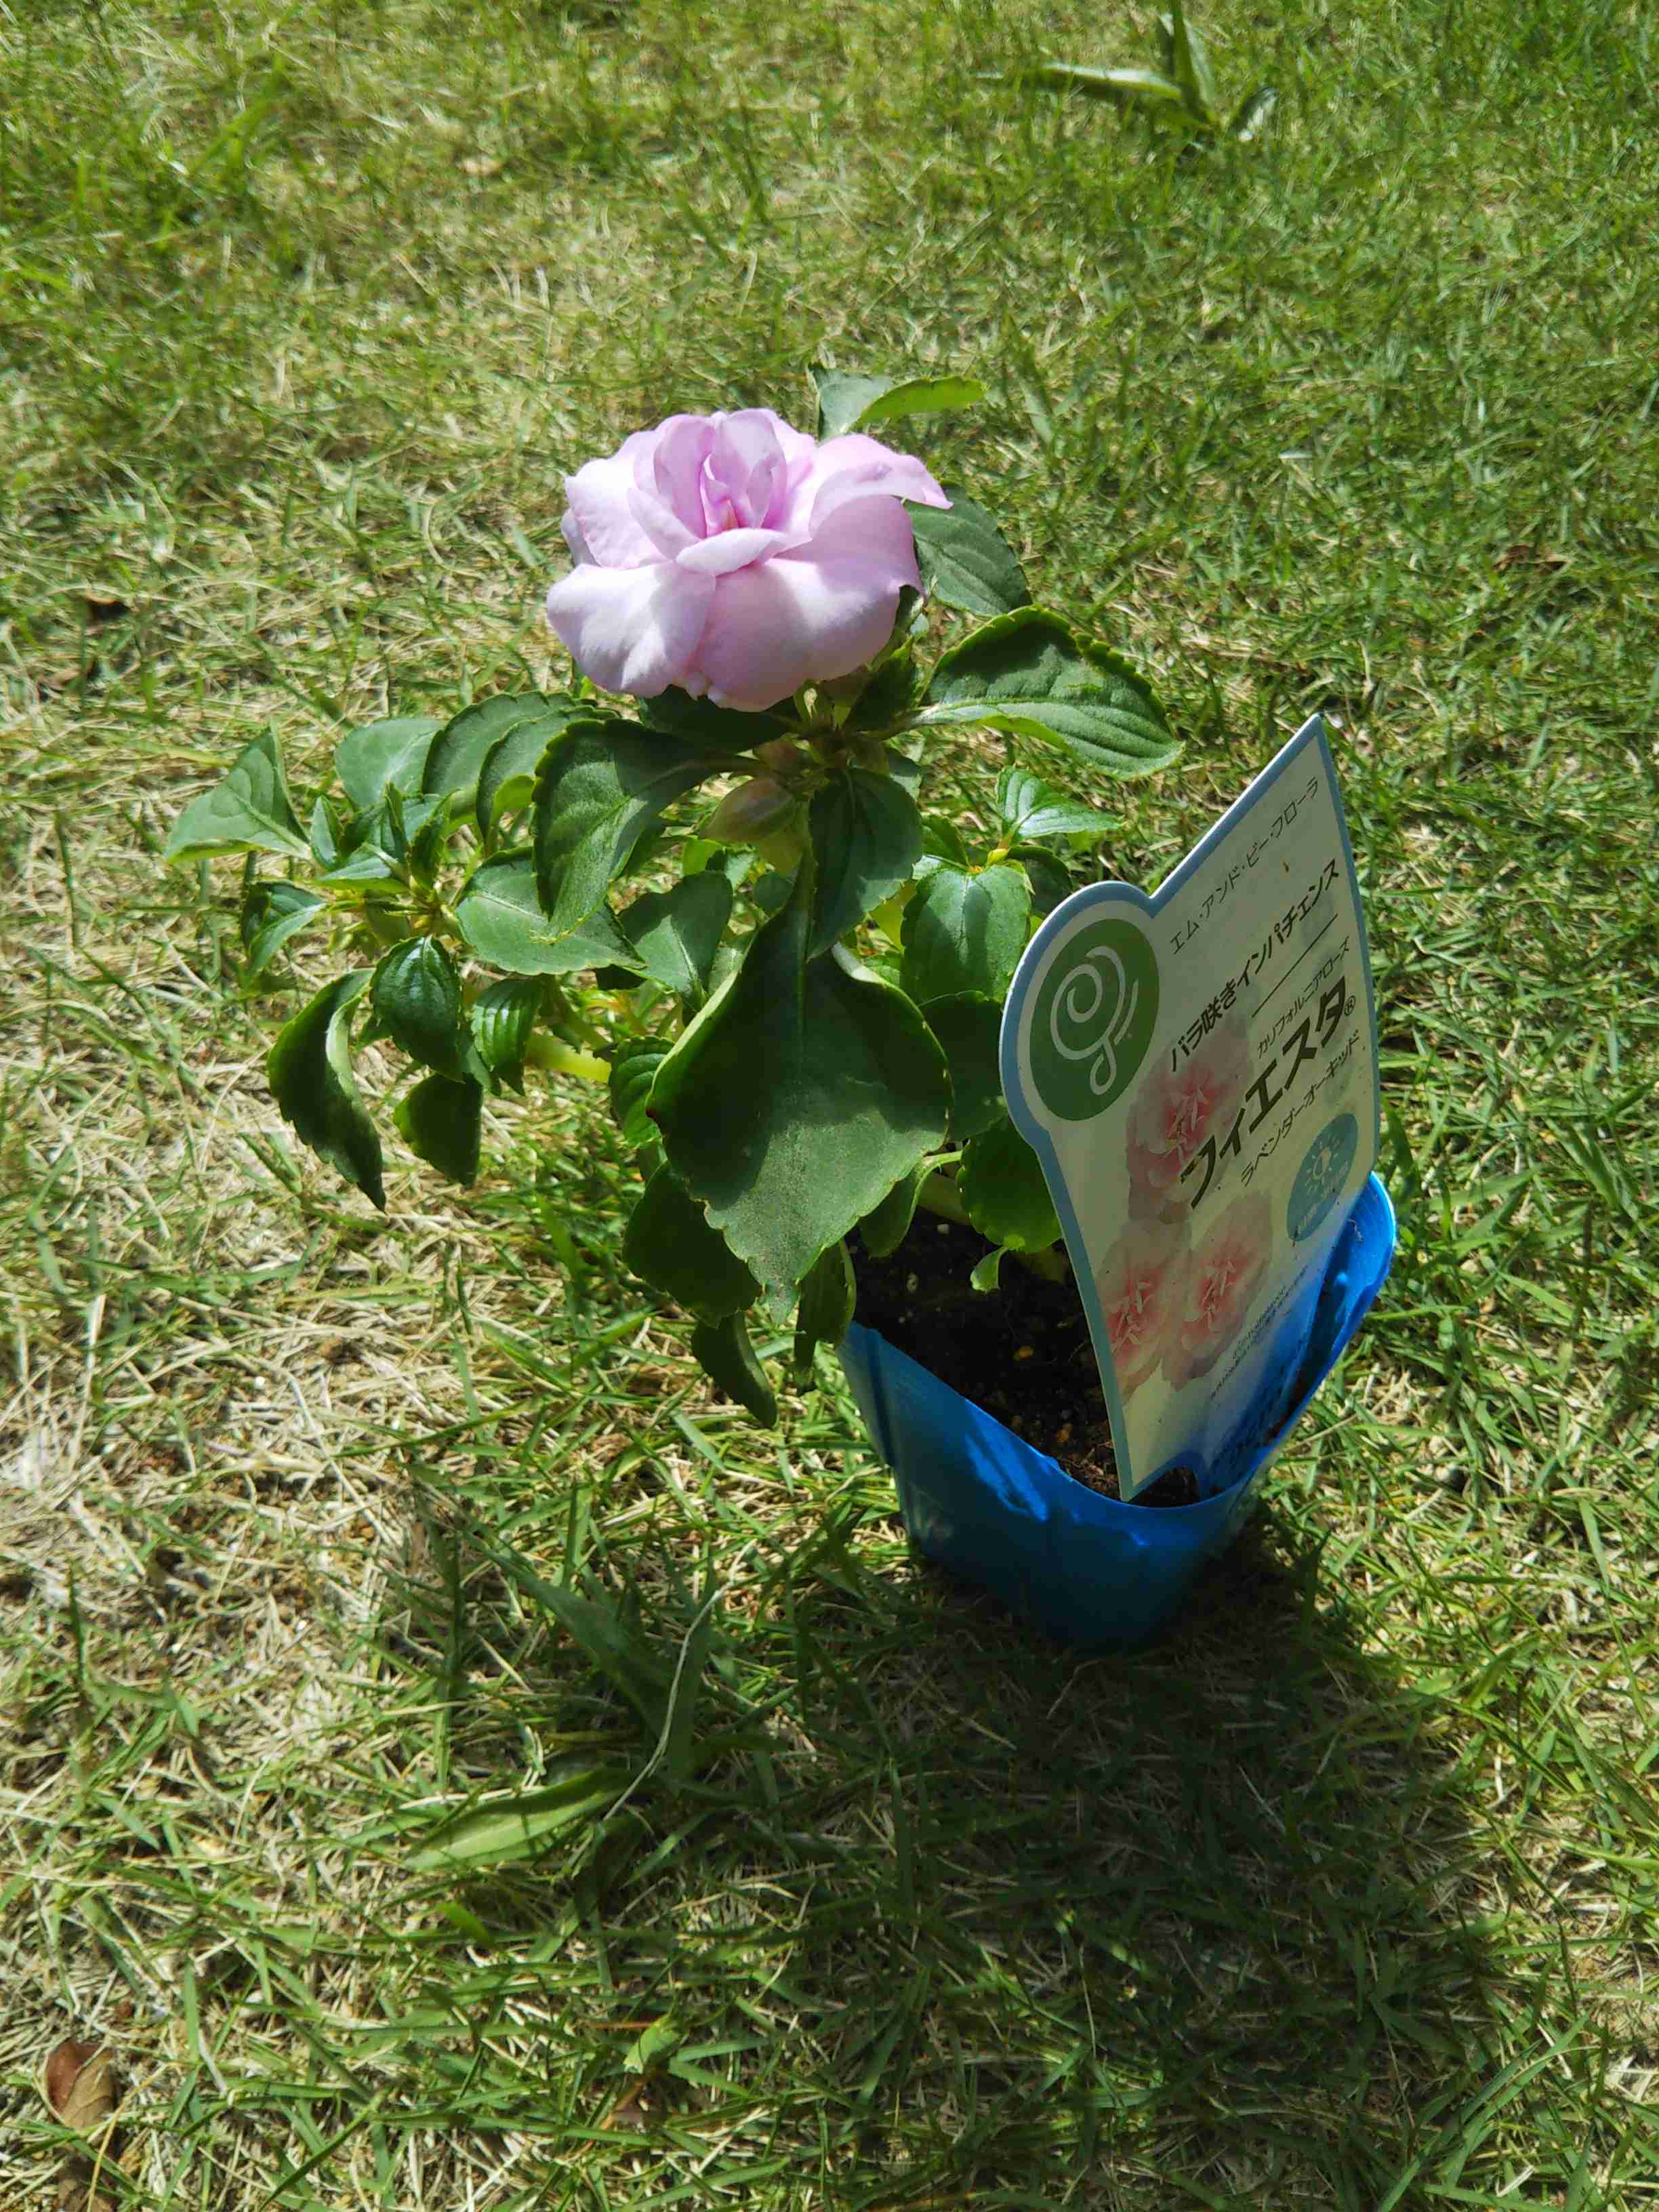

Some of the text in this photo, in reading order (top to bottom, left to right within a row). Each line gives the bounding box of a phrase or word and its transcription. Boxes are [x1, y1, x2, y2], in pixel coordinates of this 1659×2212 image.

[1172, 859, 1339, 1072] バラ咲きインパチェンス
[1242, 1029, 1359, 1187] ラベンダーオーキッド
